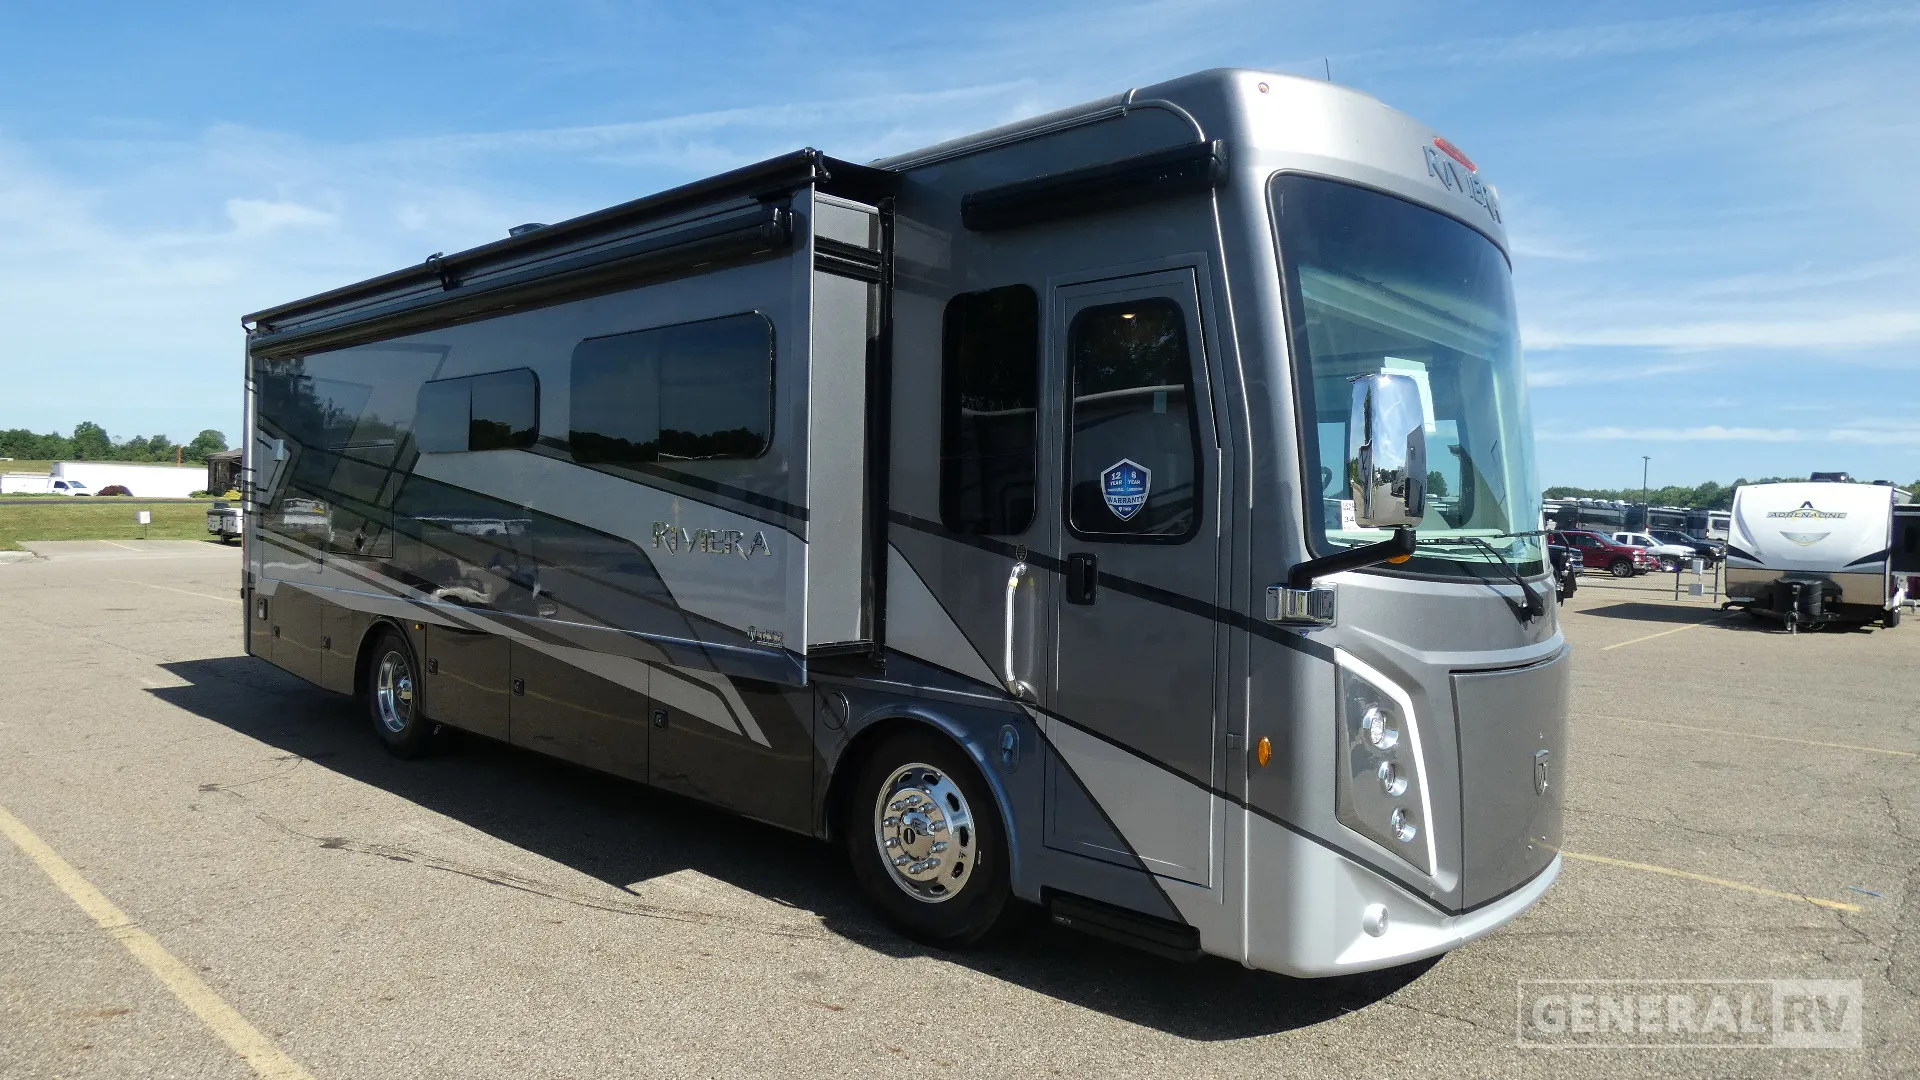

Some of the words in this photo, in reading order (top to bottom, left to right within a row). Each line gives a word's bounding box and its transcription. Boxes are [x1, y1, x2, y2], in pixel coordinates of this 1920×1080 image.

[1111, 472, 1122, 480] 12
[1768, 511, 1846, 519] ADRENALINE
[652, 521, 771, 560] RIVIERA
